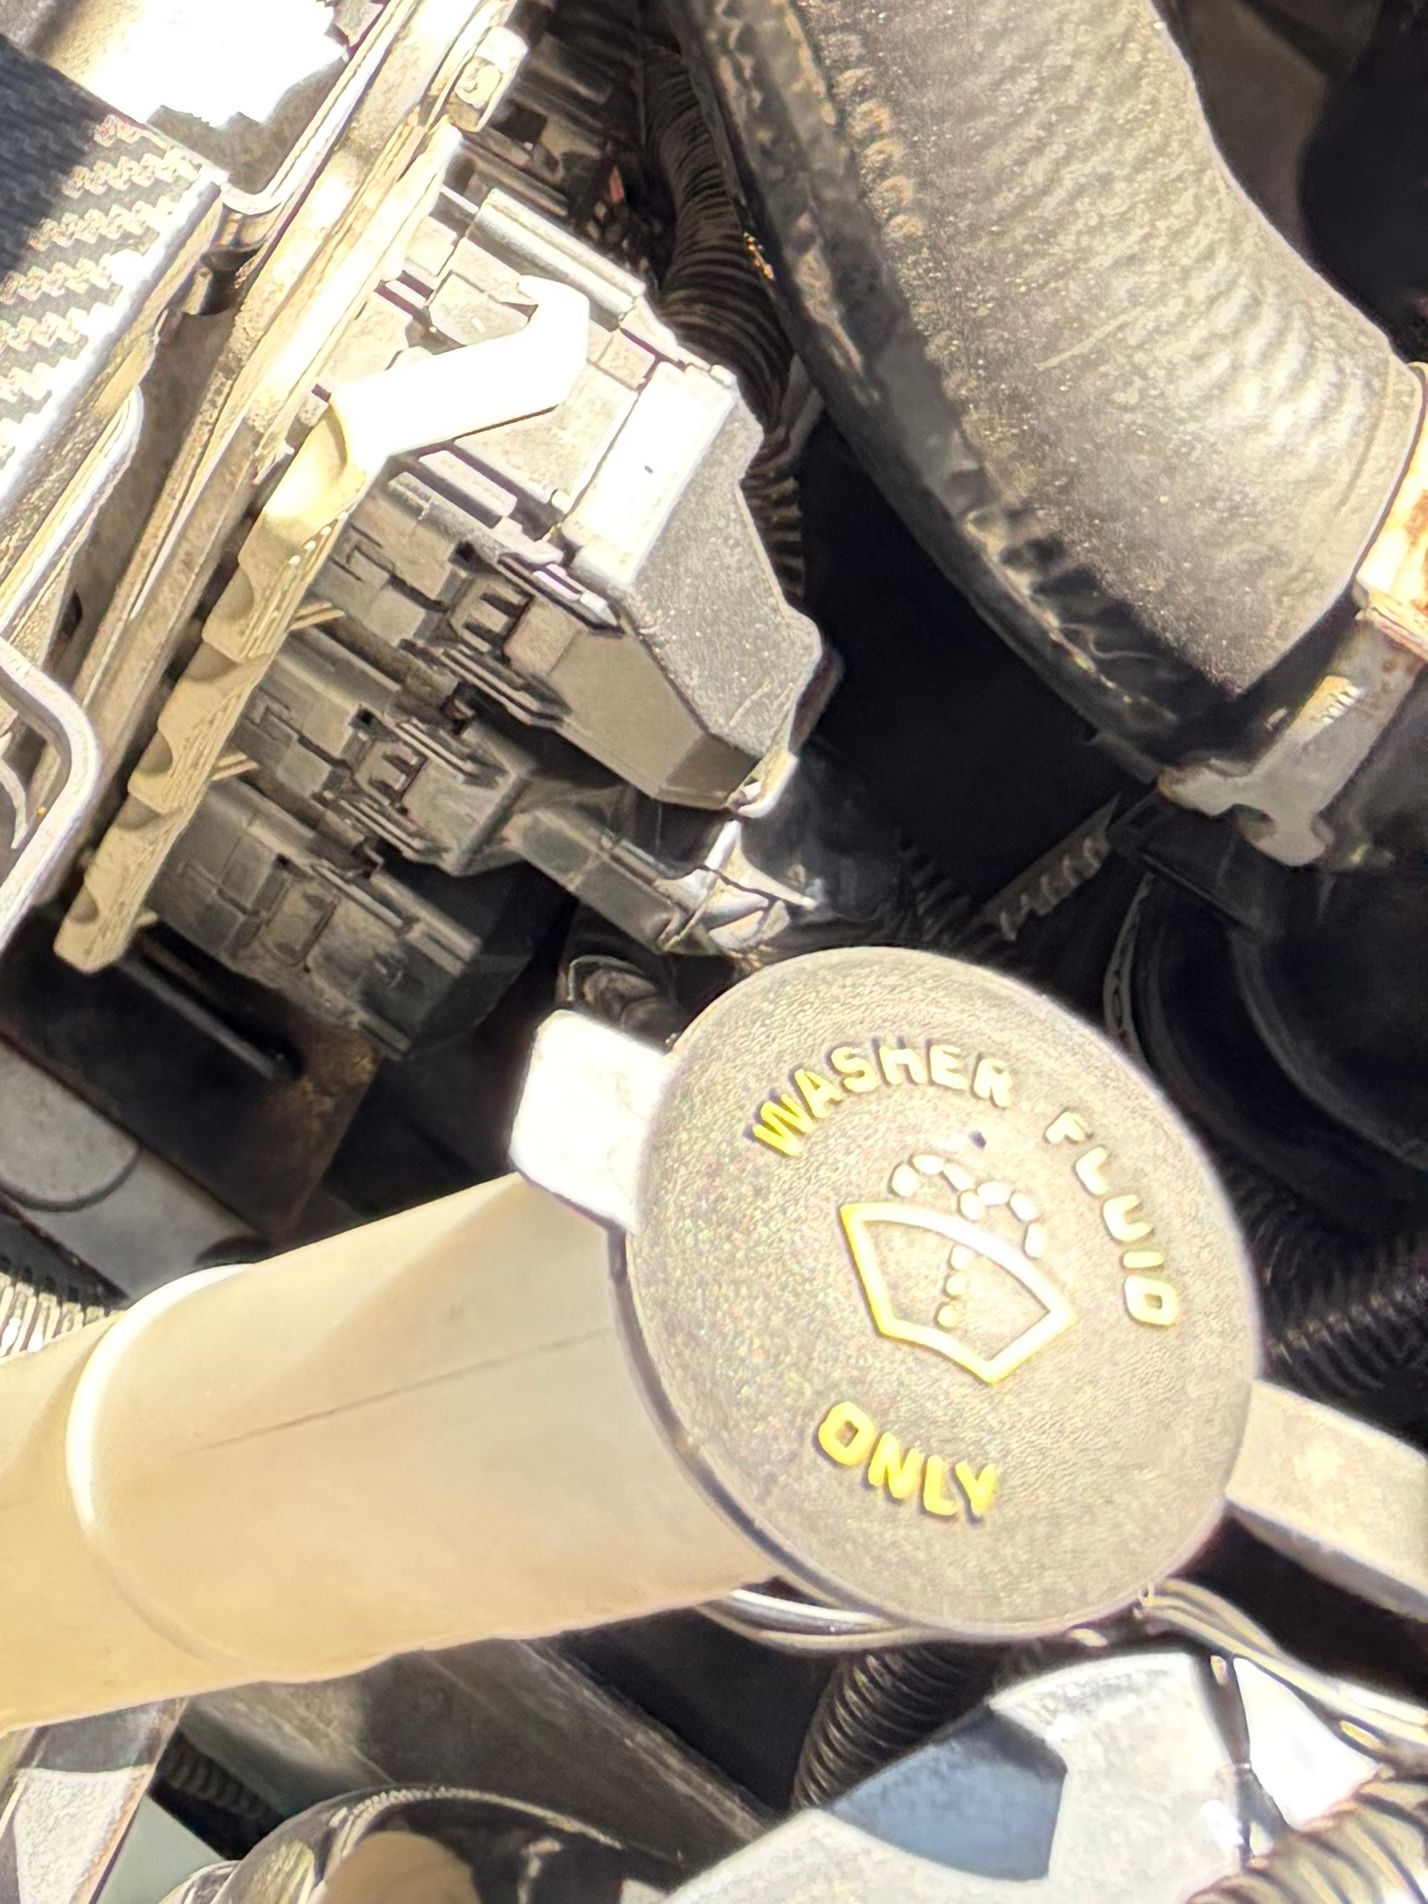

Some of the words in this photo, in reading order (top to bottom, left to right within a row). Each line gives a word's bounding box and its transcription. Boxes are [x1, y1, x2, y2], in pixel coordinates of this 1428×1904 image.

[749, 1040, 1014, 1158] WASHER
[1044, 1109, 1180, 1327] FLUID
[815, 1399, 999, 1518] ONLY
